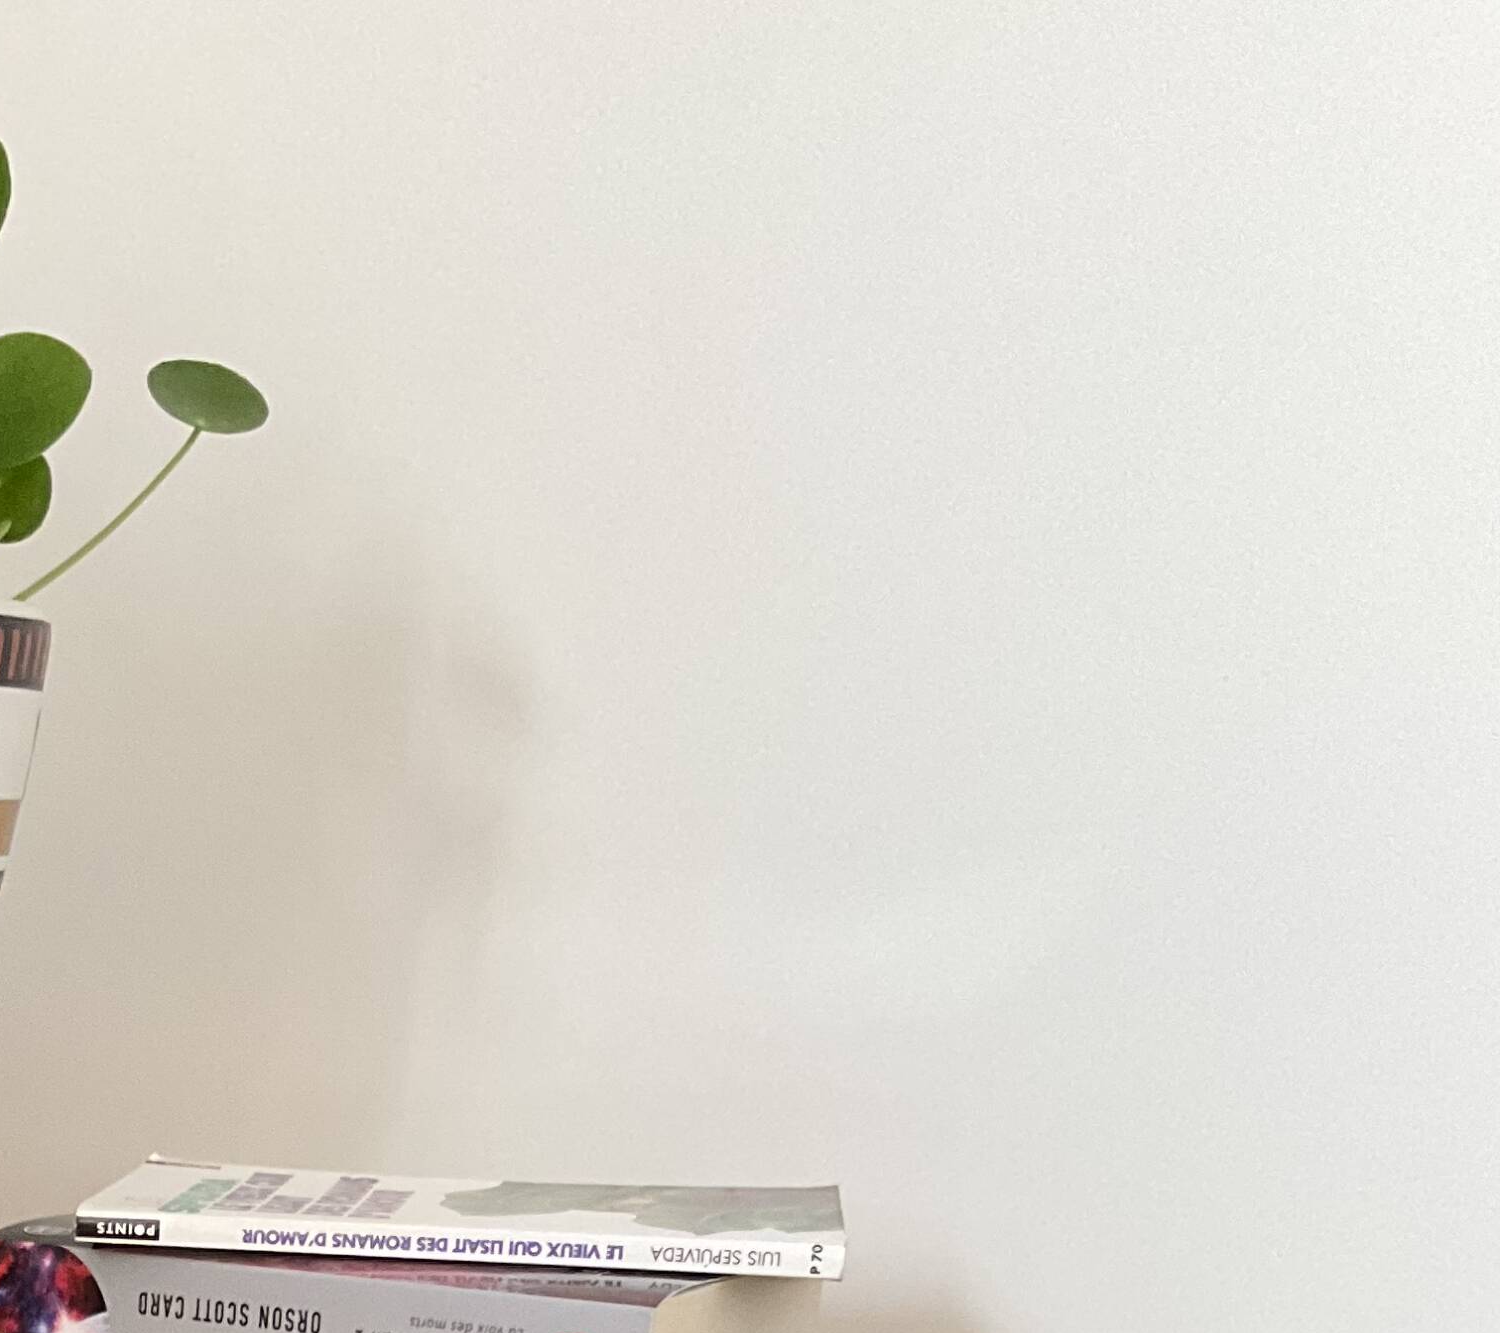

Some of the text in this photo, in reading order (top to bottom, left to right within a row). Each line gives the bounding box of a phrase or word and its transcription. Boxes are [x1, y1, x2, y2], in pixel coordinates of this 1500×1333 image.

[97, 1221, 156, 1237] POINTS
[242, 1228, 624, 1261] LE VIEUX QUI LISAIT DES ROMANS D'AMOUR
[651, 1246, 781, 1268] LUIS SEPÚLVEDA
[810, 1244, 824, 1275] P 70
[138, 1292, 185, 1319] CARD
[192, 1298, 250, 1327] SCOTT
[410, 1316, 446, 1330] morts
